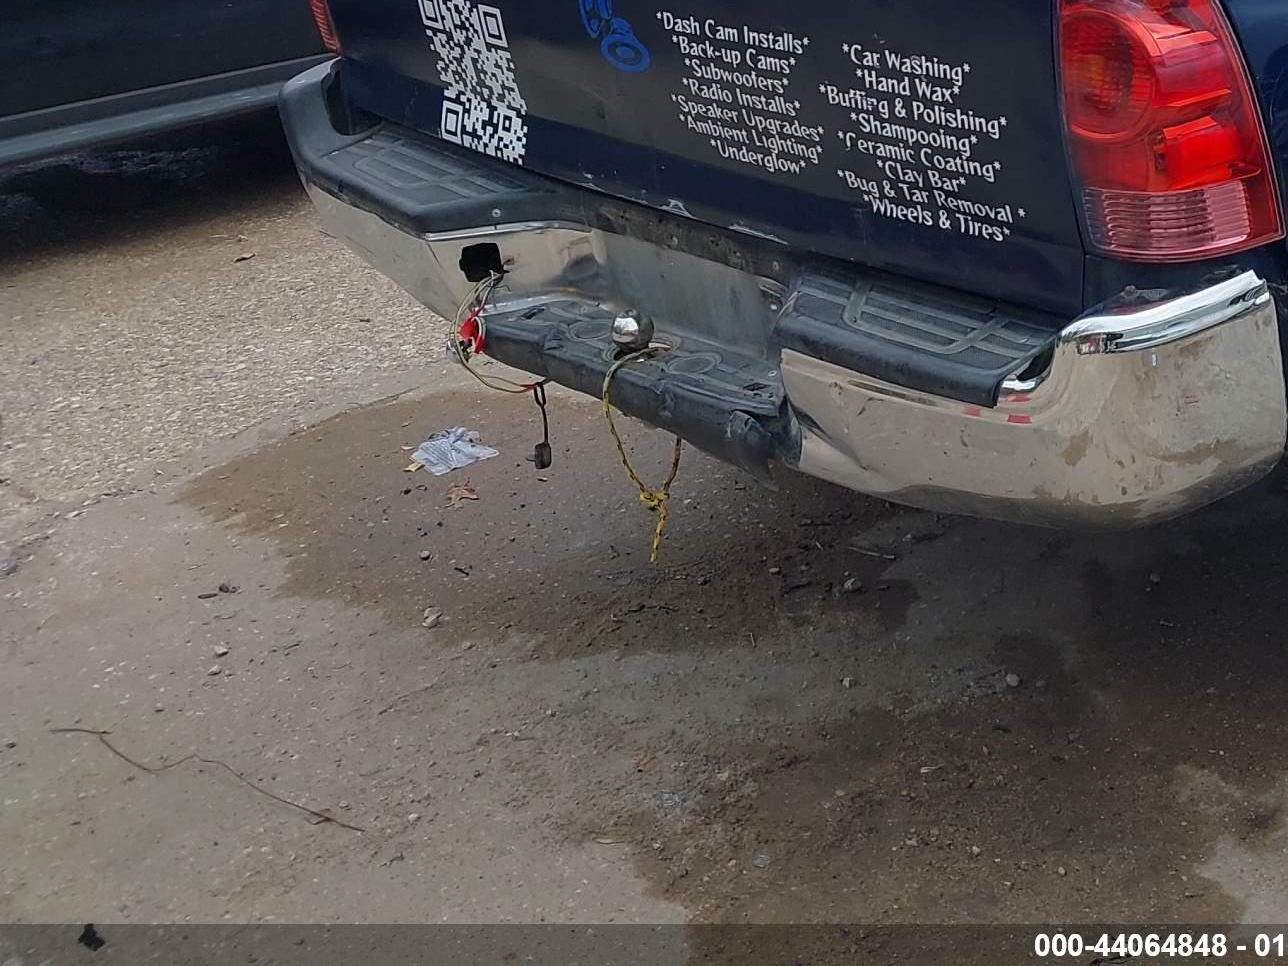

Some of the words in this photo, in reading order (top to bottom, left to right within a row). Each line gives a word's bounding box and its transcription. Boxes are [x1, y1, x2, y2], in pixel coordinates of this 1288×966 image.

[704, 19, 739, 43] Cam
[894, 97, 907, 118] &
[882, 180, 897, 198] &
[898, 183, 930, 204] Tar
[933, 190, 1014, 224] Removal
[938, 209, 952, 230] &
